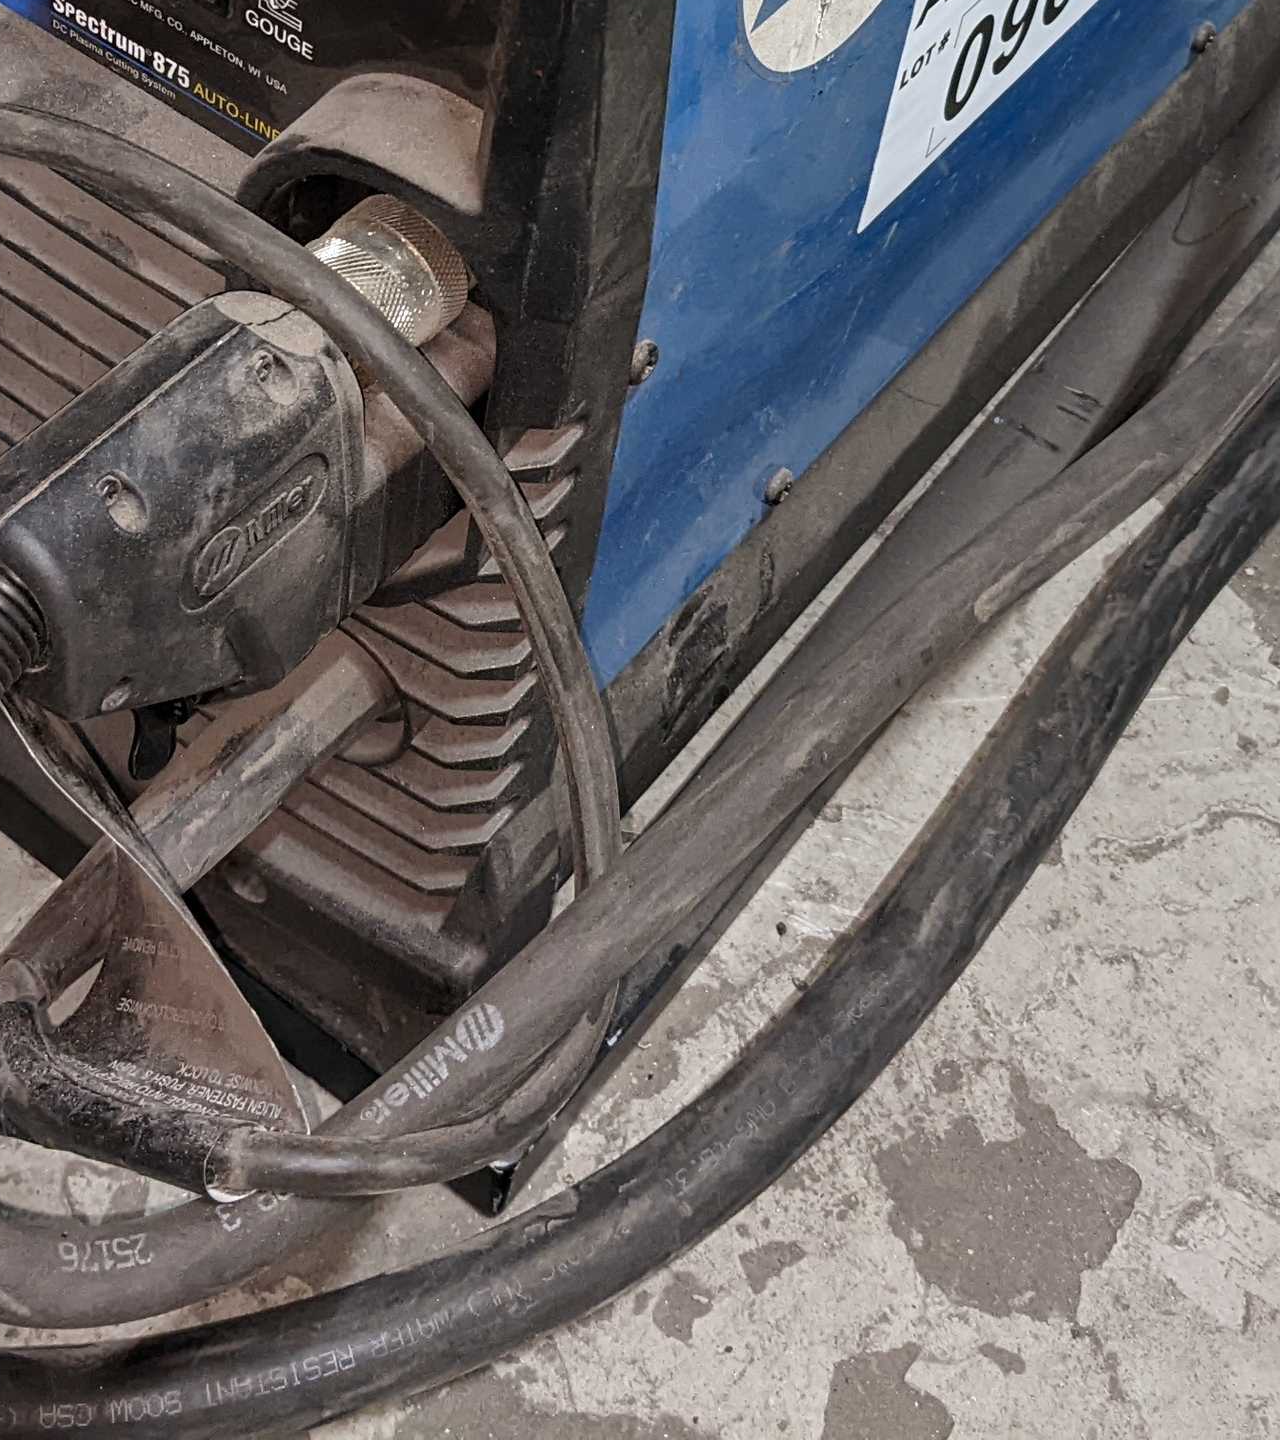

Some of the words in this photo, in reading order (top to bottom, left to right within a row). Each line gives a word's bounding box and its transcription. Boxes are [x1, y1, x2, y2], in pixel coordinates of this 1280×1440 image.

[140, 0, 165, 22] MFG.
[248, 64, 261, 78] WI
[265, 74, 288, 95] USA
[245, 9, 314, 60] GOUGE
[53, 19, 68, 35] DC
[69, 28, 103, 57] Plasma
[105, 49, 139, 79] Cutting
[141, 68, 176, 100] System
[152, 50, 191, 89] 875
[899, 43, 936, 90] LOT
[154, 1073, 185, 1090] PUSH
[373, 1036, 468, 1124] Miller
[246, 1096, 280, 1117] ALIGN
[56, 1231, 153, 1272] 25176
[199, 1343, 356, 1406] RESISTANT
[38, 1403, 92, 1427] CSA
